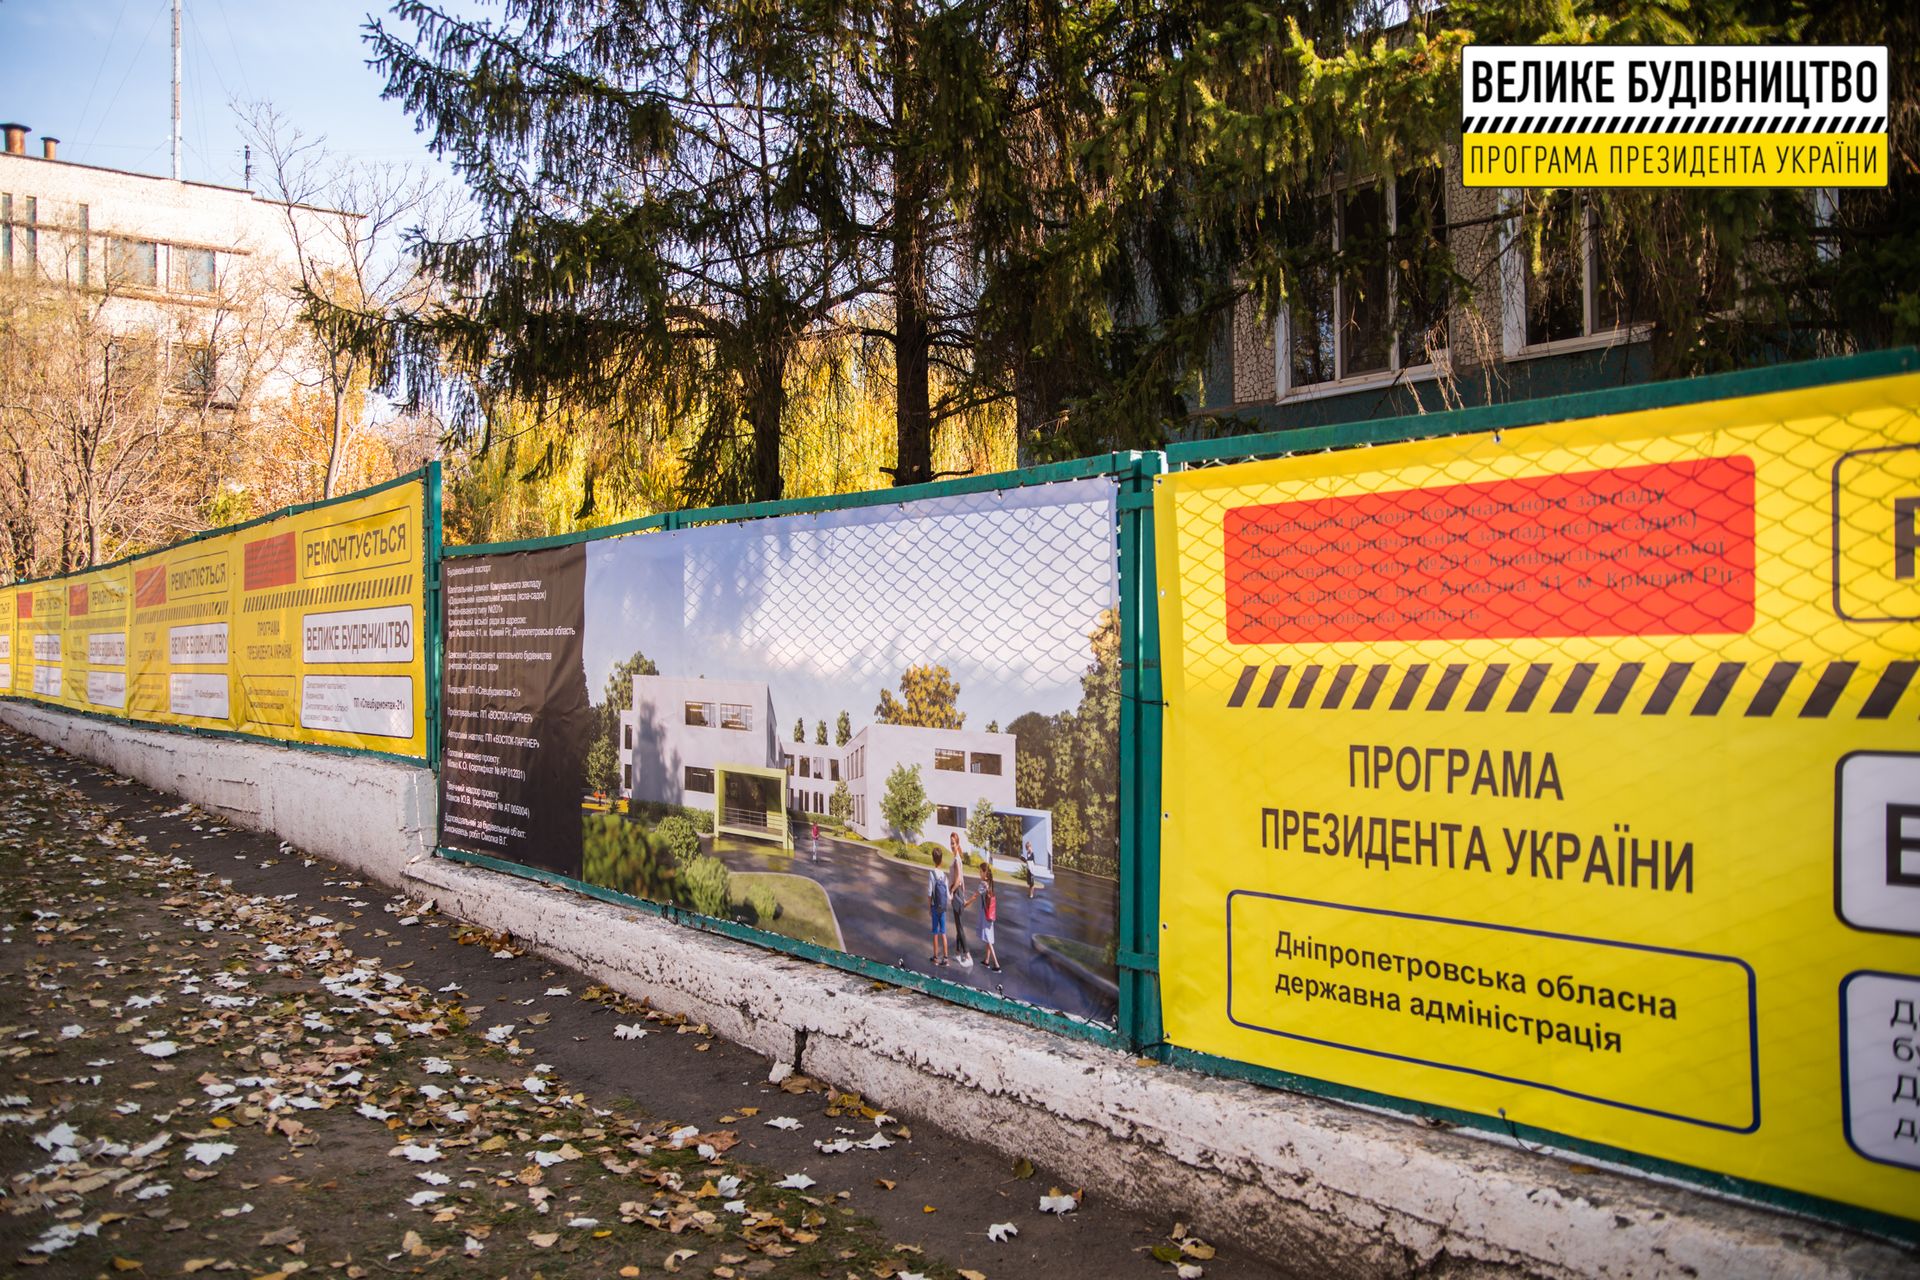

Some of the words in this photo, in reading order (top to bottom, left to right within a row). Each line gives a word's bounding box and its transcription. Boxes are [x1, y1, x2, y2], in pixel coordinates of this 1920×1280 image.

[1421, 496, 1567, 522] Комунального
[1576, 487, 1666, 508] закладу
[306, 523, 406, 568] РЕМОНТУЄТЬСЯ
[170, 563, 226, 592] РЕМОНТУЄТЬСЯ
[306, 625, 339, 651] ВЕЛИКЕ
[342, 620, 410, 655] БУДІВНИЦТВО
[1349, 744, 1565, 802] ПРОГРАМА
[1261, 807, 1492, 873] ПРЕЗИДЕНТА
[1502, 824, 1695, 894] УКРАЇНИ
[1275, 930, 1527, 995] Дніпропетровська
[1536, 973, 1678, 1021] обласна
[1275, 973, 1401, 1012] державна
[1409, 997, 1622, 1054] адміністрація
